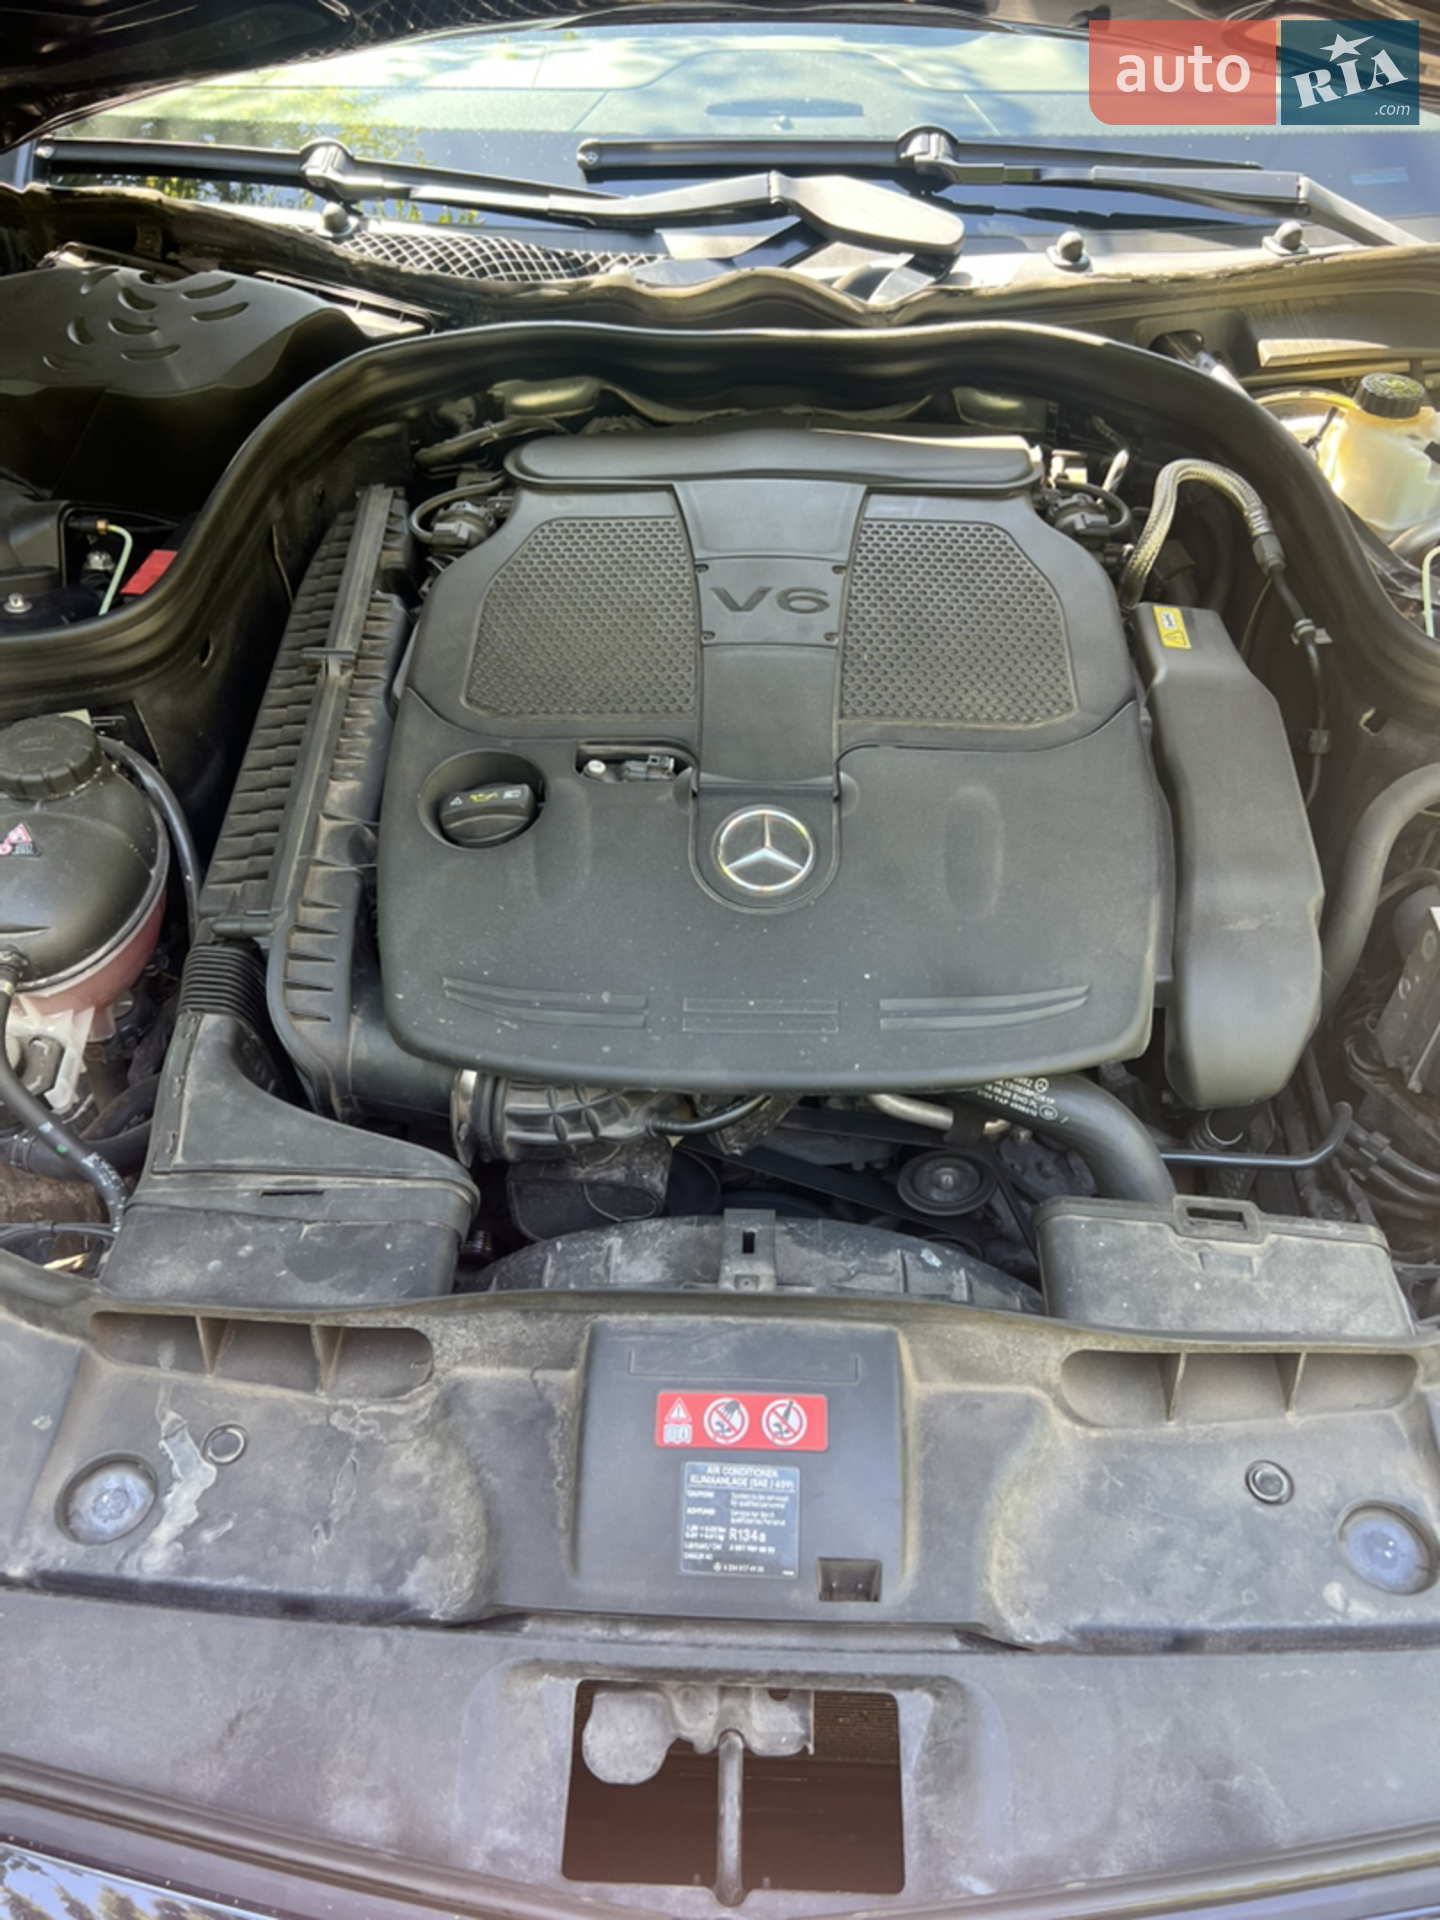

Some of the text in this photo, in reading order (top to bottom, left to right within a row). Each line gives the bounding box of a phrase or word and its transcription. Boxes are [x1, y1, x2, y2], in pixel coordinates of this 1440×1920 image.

[710, 586, 830, 614] V6
[706, 1465, 778, 1478] AIR CONDITIONER
[689, 1475, 748, 1487] KLIMAANLAGE
[729, 1527, 767, 1543] R134a
